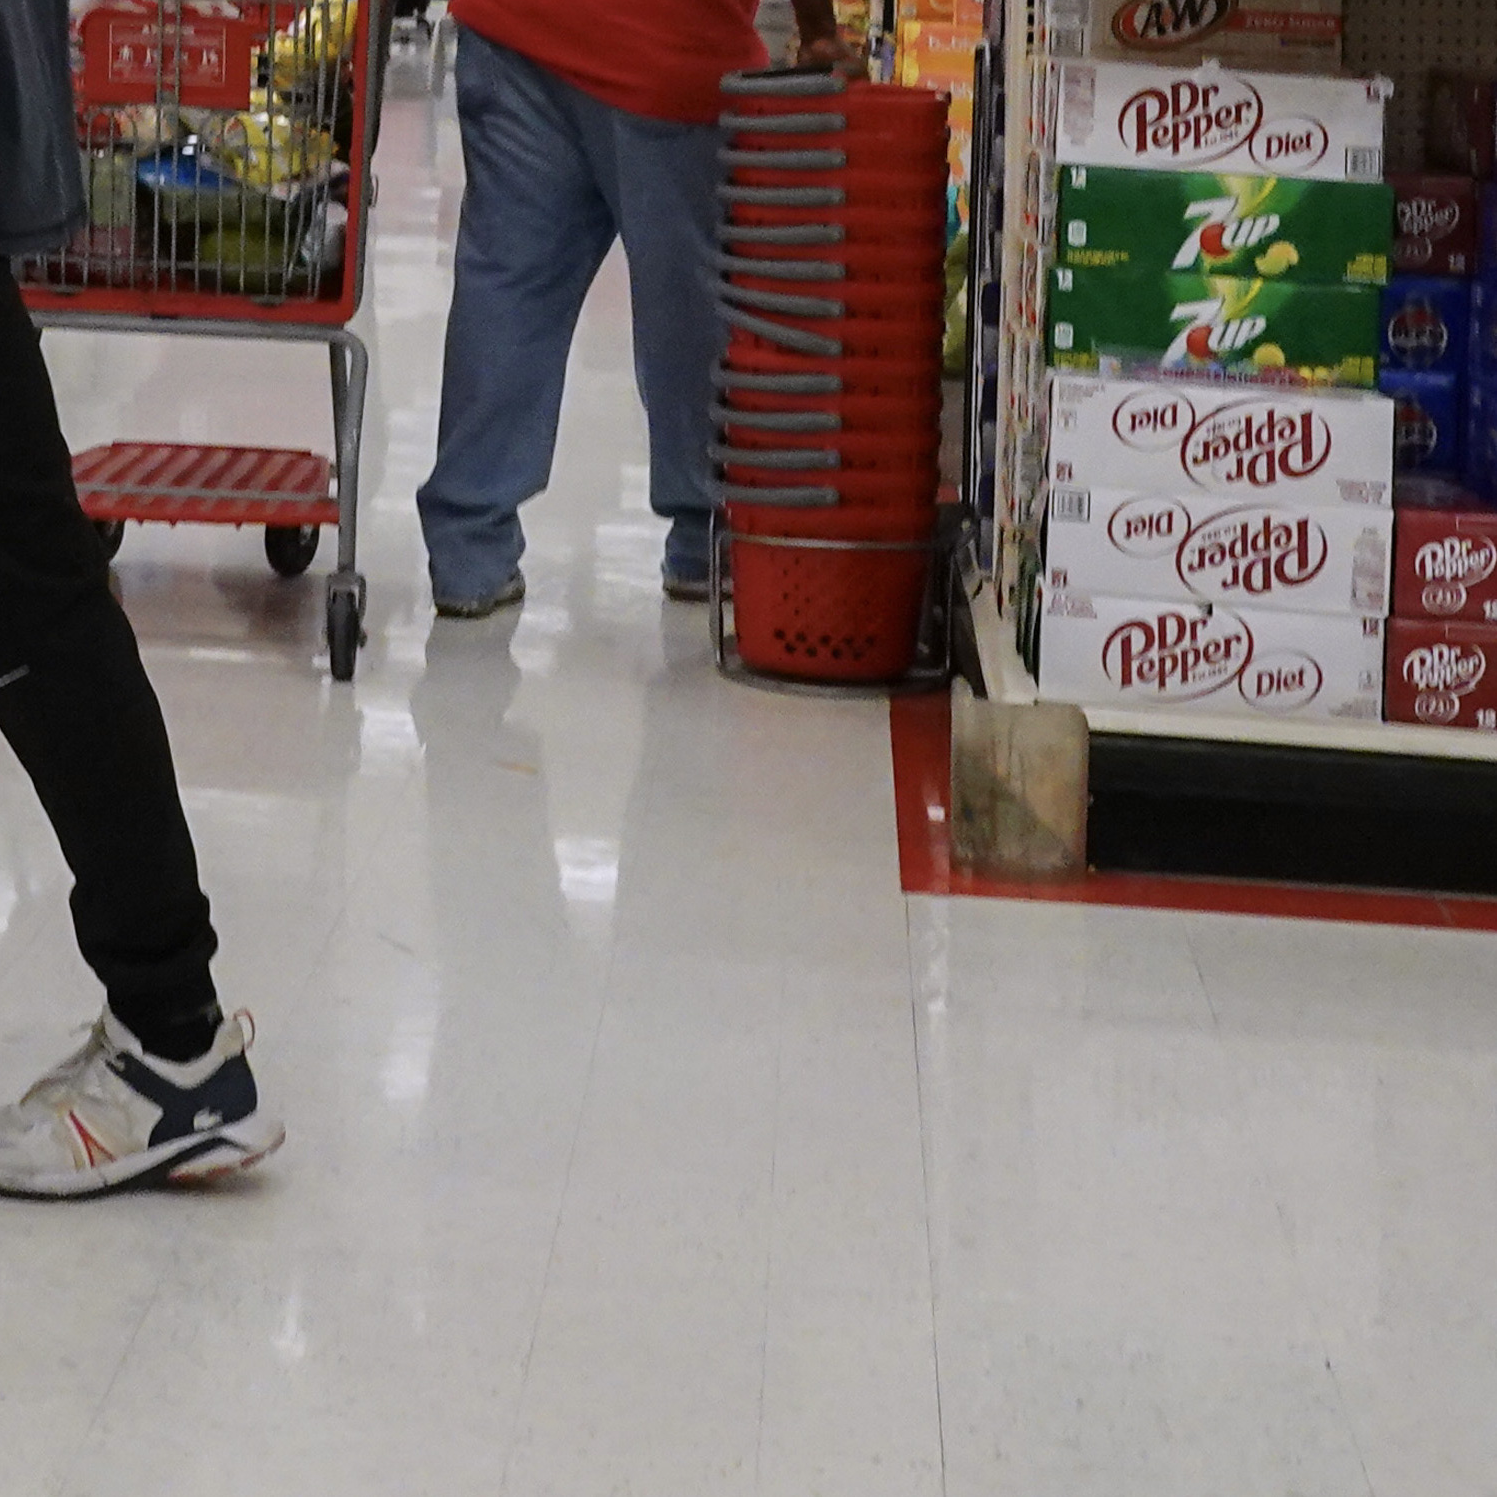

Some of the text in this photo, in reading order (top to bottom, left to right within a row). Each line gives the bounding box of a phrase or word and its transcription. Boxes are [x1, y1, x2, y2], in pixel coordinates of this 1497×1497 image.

[1171, 79, 1219, 118] Dr
[1120, 87, 1253, 157] Pepper
[1265, 131, 1313, 161] Diet
[1129, 407, 1178, 434] Diet
[1193, 409, 1325, 478] Pepper
[1226, 440, 1278, 487] Dr
[1124, 511, 1174, 533] Diet
[1188, 515, 1323, 586] Pepper
[1222, 547, 1272, 594] Dr
[1158, 613, 1208, 656] Dr
[1104, 622, 1243, 693] Pepper
[1256, 669, 1306, 698] Diet
